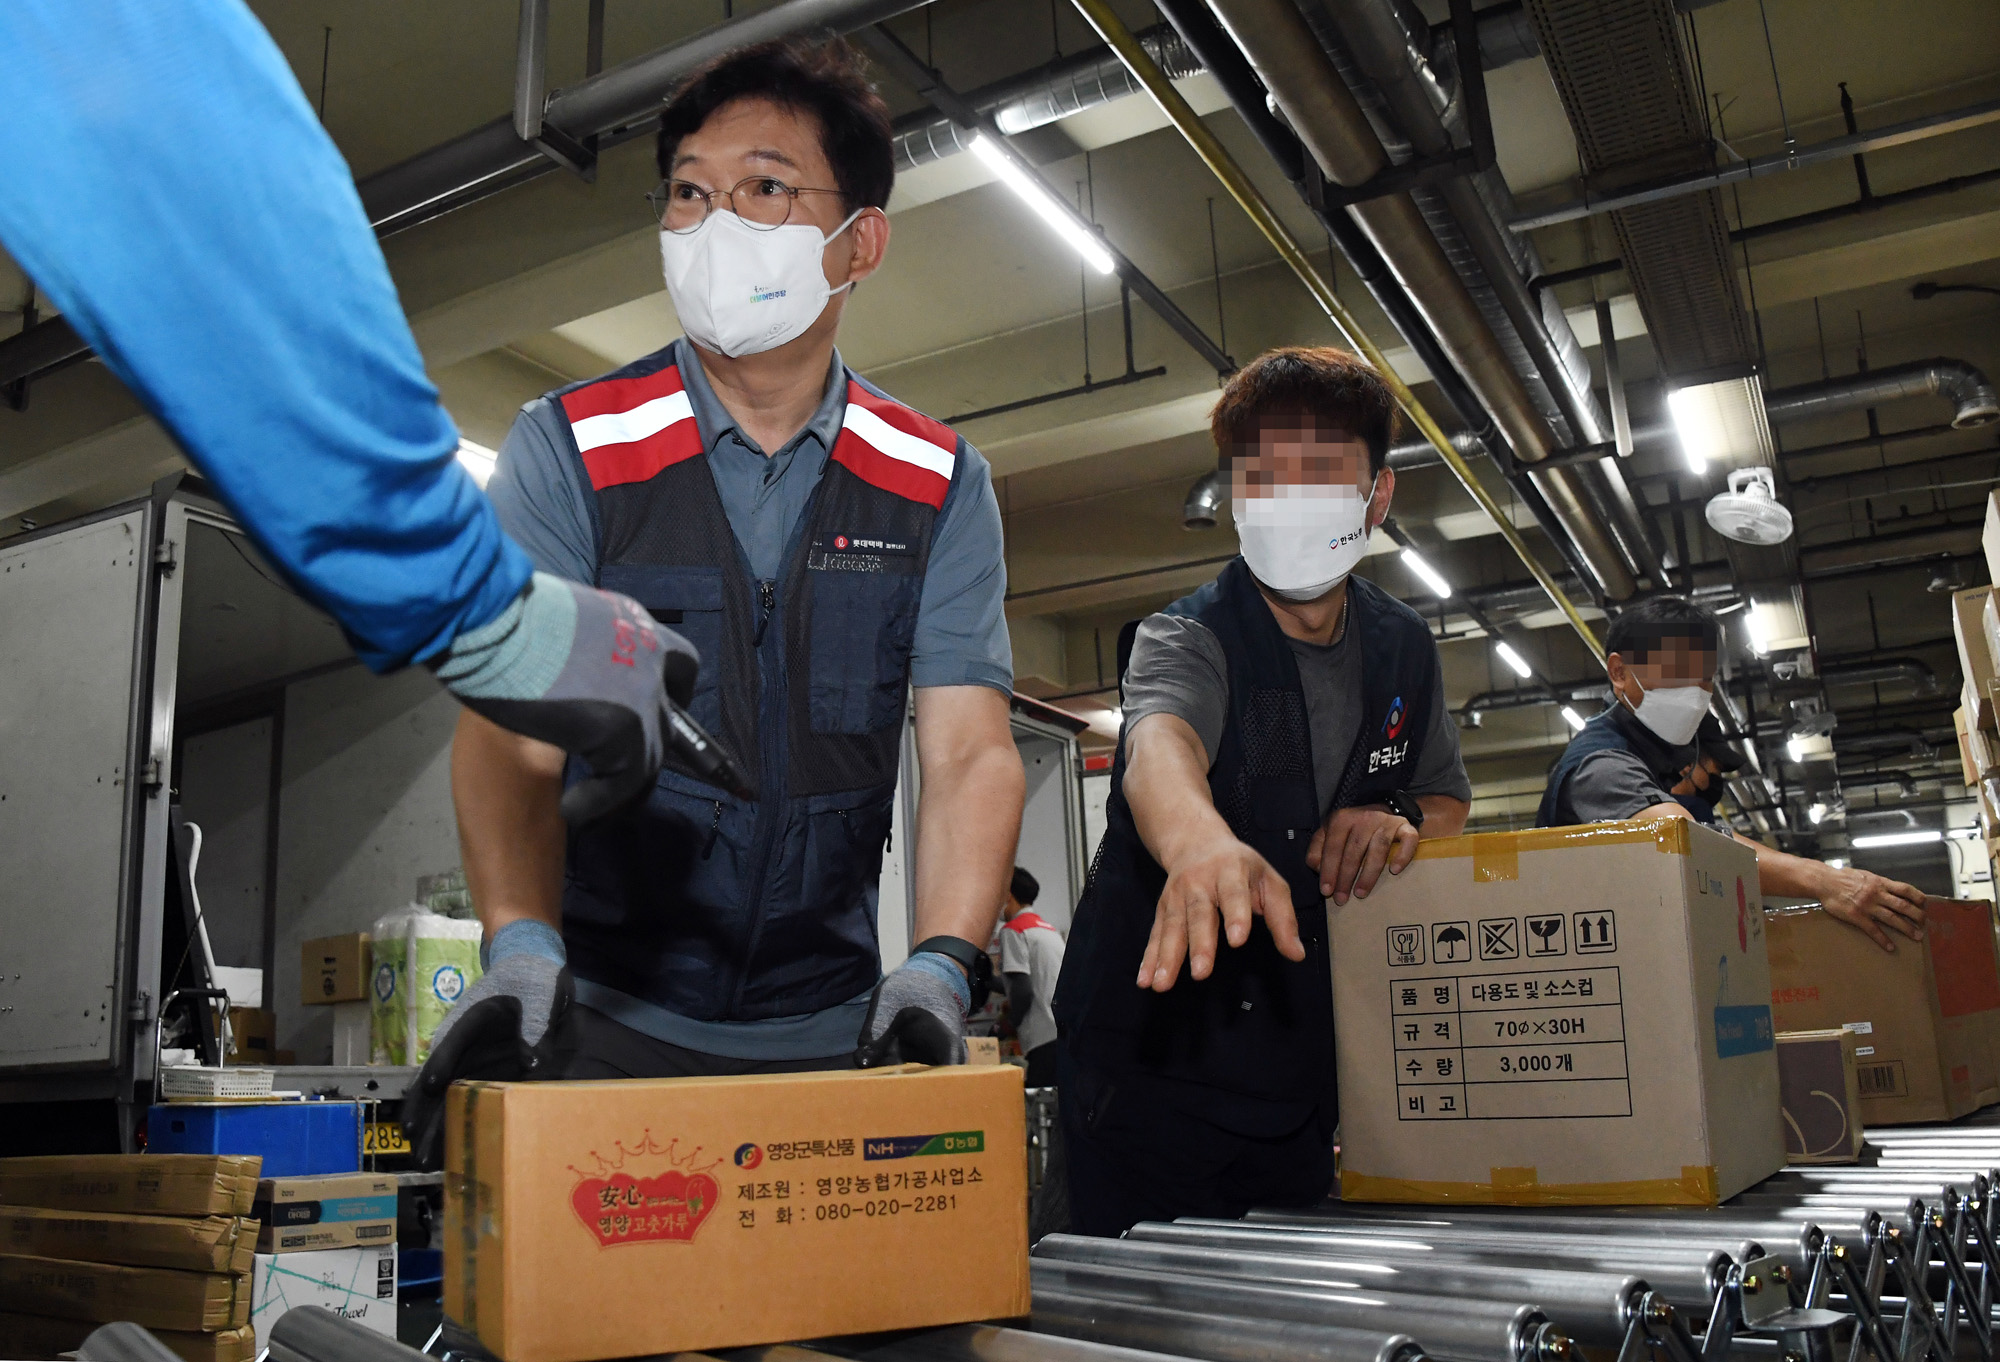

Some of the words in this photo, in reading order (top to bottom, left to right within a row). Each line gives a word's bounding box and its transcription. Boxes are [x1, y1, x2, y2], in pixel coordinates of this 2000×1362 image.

[1397, 954, 1416, 964] 식품용
[1471, 983, 1520, 1002] 다용도
[1524, 981, 1539, 1000] 및
[1544, 977, 1594, 997] 소스컵
[766, 1138, 855, 1161] 영양군특산품
[868, 1142, 894, 1155] NH
[737, 1180, 790, 1201] 제조원
[816, 1166, 984, 1197] 영양농협가공사업소
[598, 1185, 643, 1210] 安心
[815, 1194, 957, 1221] 080-020-2281
[632, 1211, 689, 1234] 고춧가루
